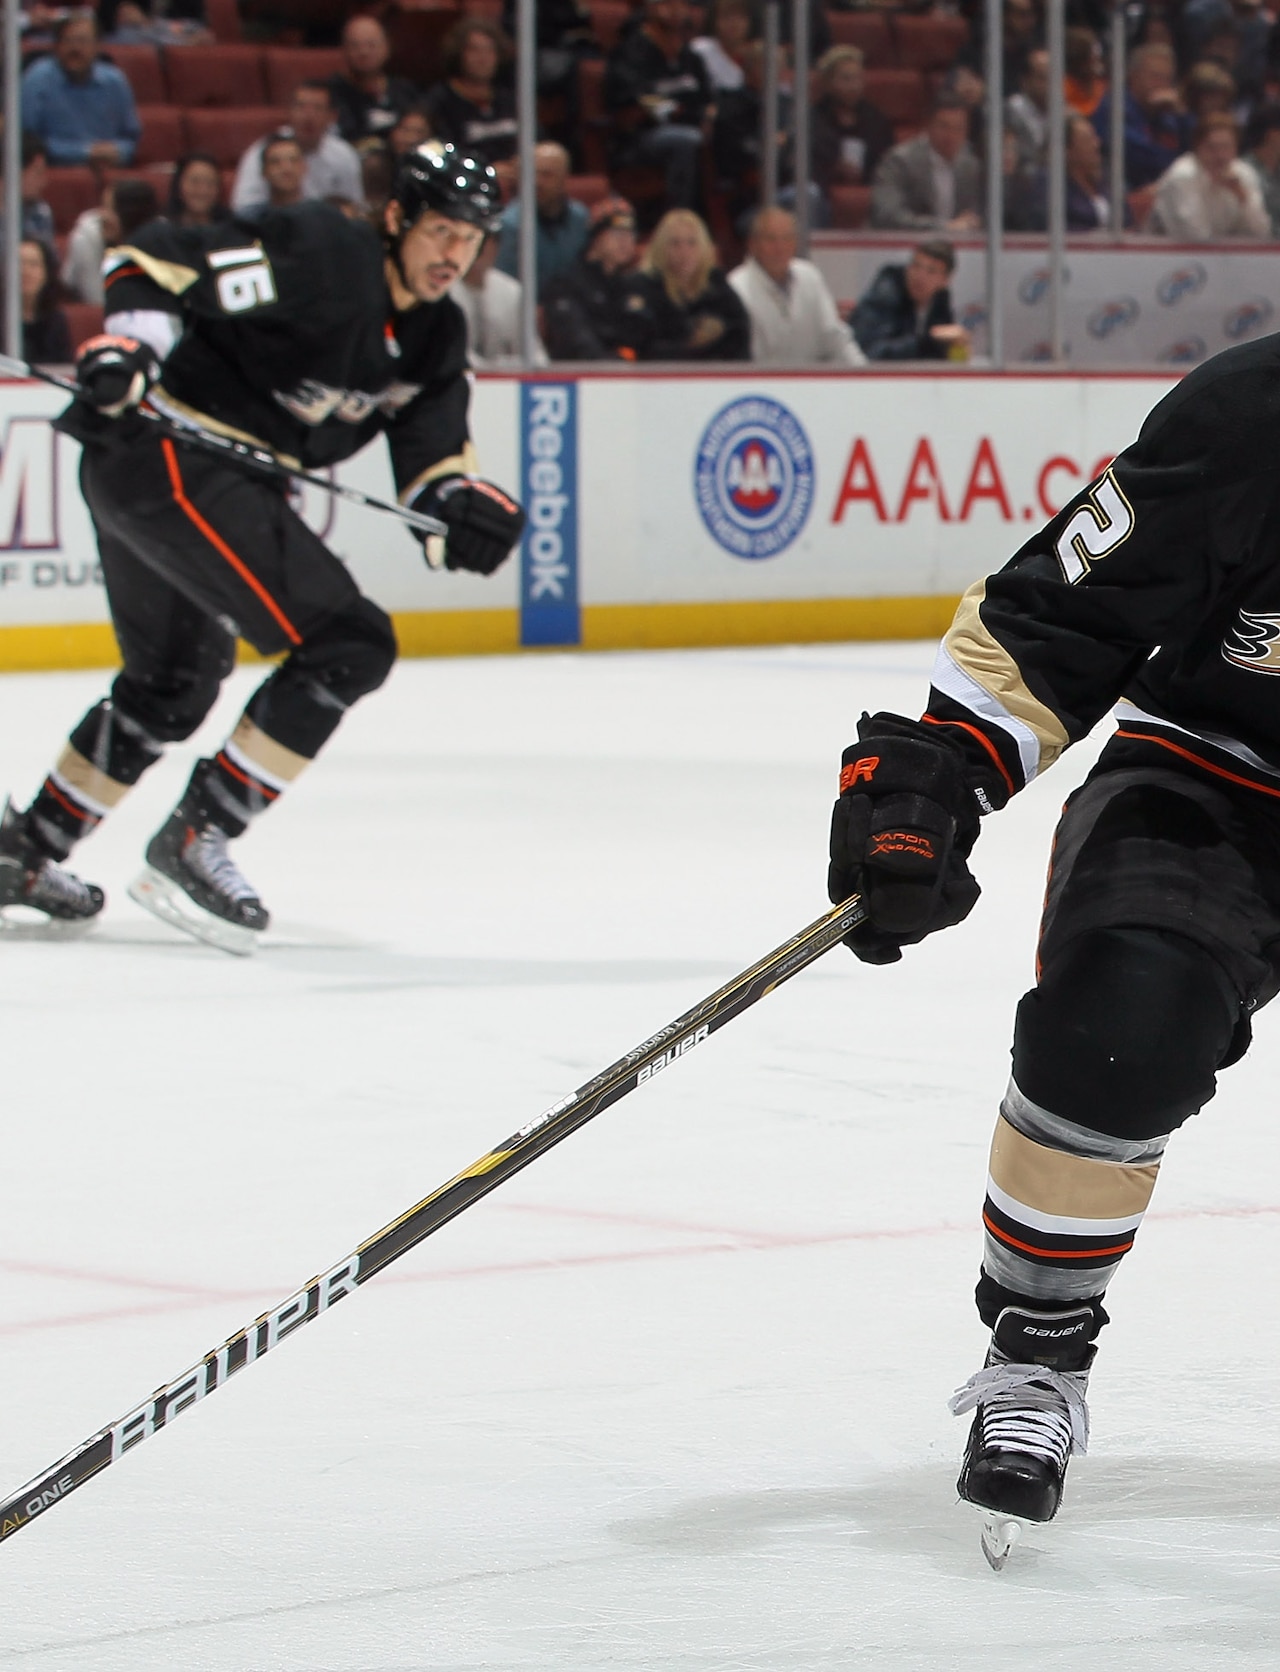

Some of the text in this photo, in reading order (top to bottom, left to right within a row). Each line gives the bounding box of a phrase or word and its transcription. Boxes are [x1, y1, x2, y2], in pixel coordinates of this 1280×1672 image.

[206, 240, 278, 314] 16
[528, 385, 570, 600] Reebok
[1053, 467, 1136, 587] 2
[635, 1022, 710, 1088] BAUER
[1022, 1321, 1086, 1339] BAUER
